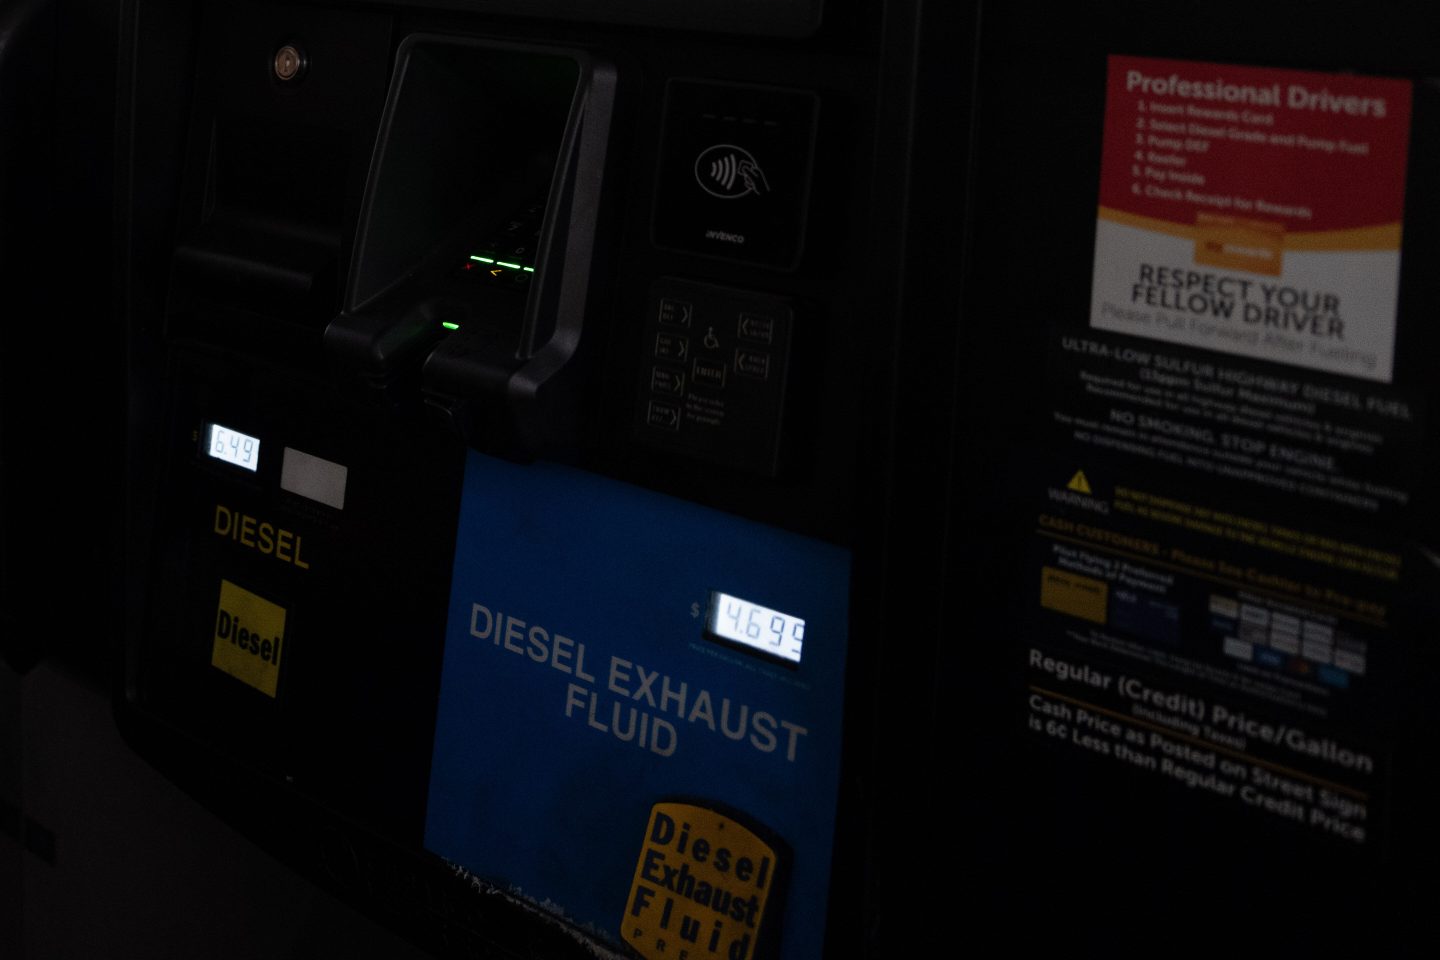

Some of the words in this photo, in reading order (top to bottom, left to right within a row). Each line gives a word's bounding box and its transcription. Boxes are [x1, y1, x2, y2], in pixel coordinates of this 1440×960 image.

[1125, 68, 1281, 108] Professional
[1286, 84, 1388, 119] Drivers
[1131, 283, 1236, 320] FELLOW
[1242, 303, 1345, 340] DRIVER
[1139, 262, 1254, 300] RESPECT
[1261, 284, 1342, 315] YOUR
[213, 504, 311, 571] DIESEL
[216, 608, 281, 666] Diesel
[690, 601, 700, 619] $
[469, 601, 597, 685] DIESEL
[607, 654, 809, 763] EXHAUST
[564, 681, 679, 759] FLUID
[1028, 646, 1113, 690] Regular
[1117, 673, 1206, 721] (Credit)
[1211, 702, 1375, 776] Price/Gallon
[1028, 693, 1072, 722] Cash
[1075, 707, 1122, 739] Price
[1125, 727, 1146, 746] as
[1149, 732, 1217, 770] Posted
[1219, 757, 1248, 782] on
[1251, 764, 1314, 802] Street
[1318, 786, 1368, 822] Sign
[1072, 727, 1111, 755] Less
[1114, 741, 1158, 772] than
[1160, 755, 1236, 797] Regular
[1239, 783, 1306, 824] Credit
[1310, 806, 1367, 845] Price
[641, 847, 759, 929] Exhaust
[650, 811, 771, 890] Diesel
[631, 885, 751, 960] Fluid
